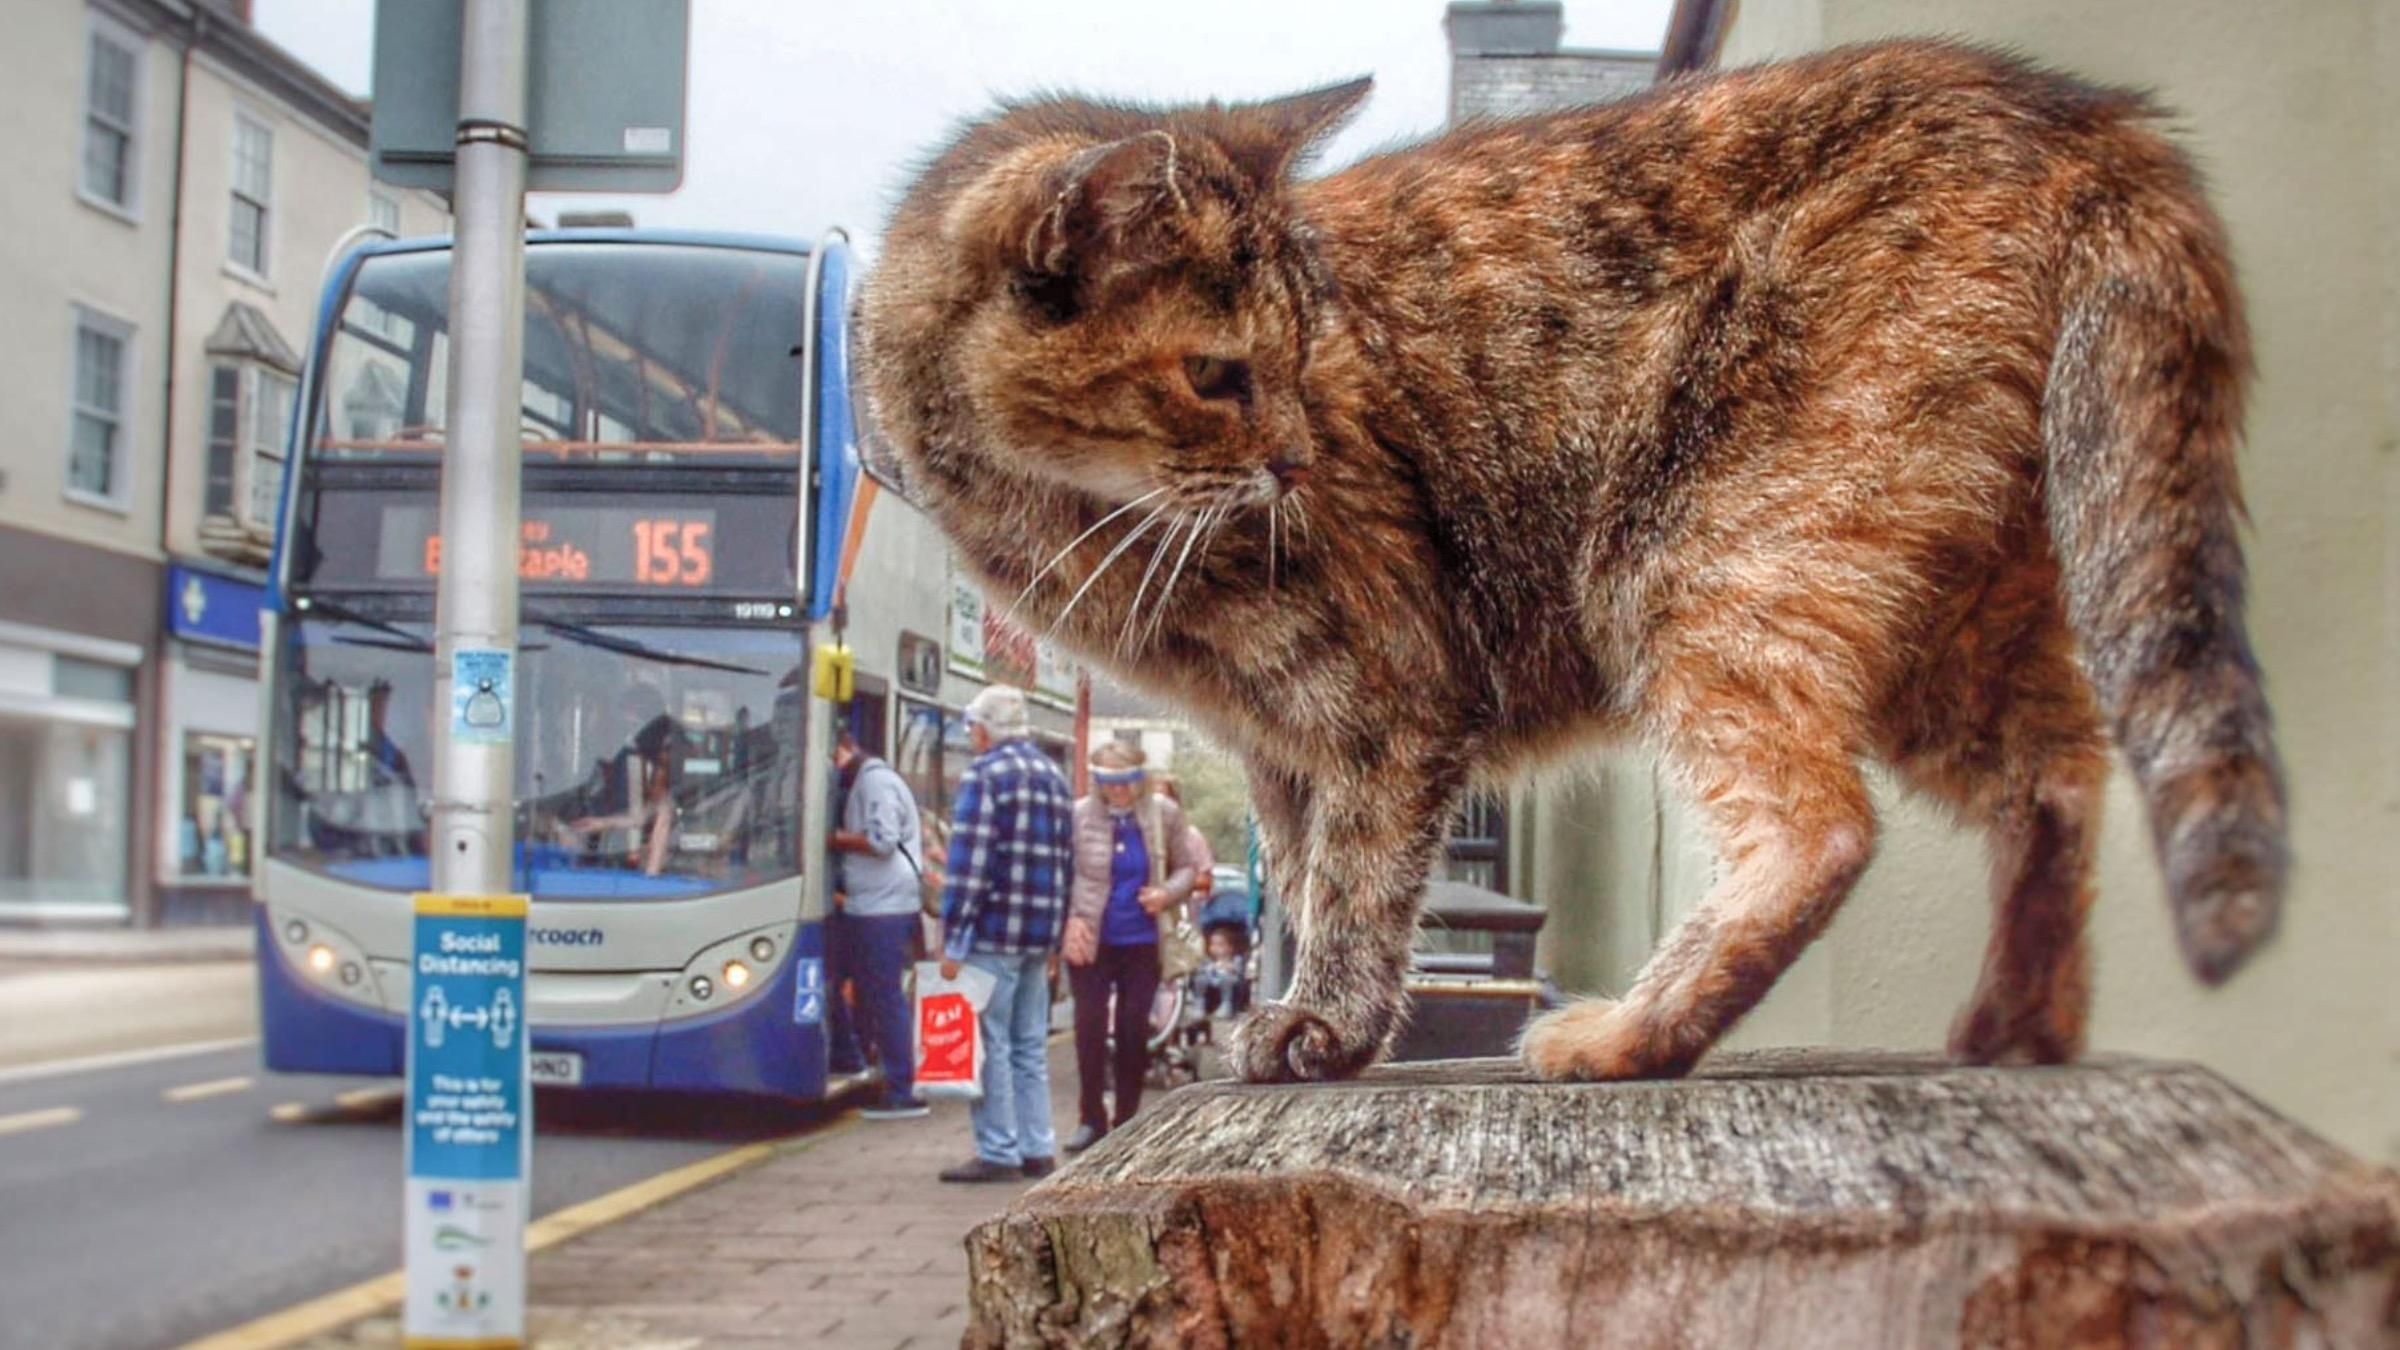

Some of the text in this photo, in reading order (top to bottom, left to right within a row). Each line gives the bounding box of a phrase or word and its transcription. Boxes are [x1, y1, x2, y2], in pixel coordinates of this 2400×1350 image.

[634, 519, 712, 585] 155
[440, 931, 501, 952] Social
[418, 954, 520, 978] Distancing
